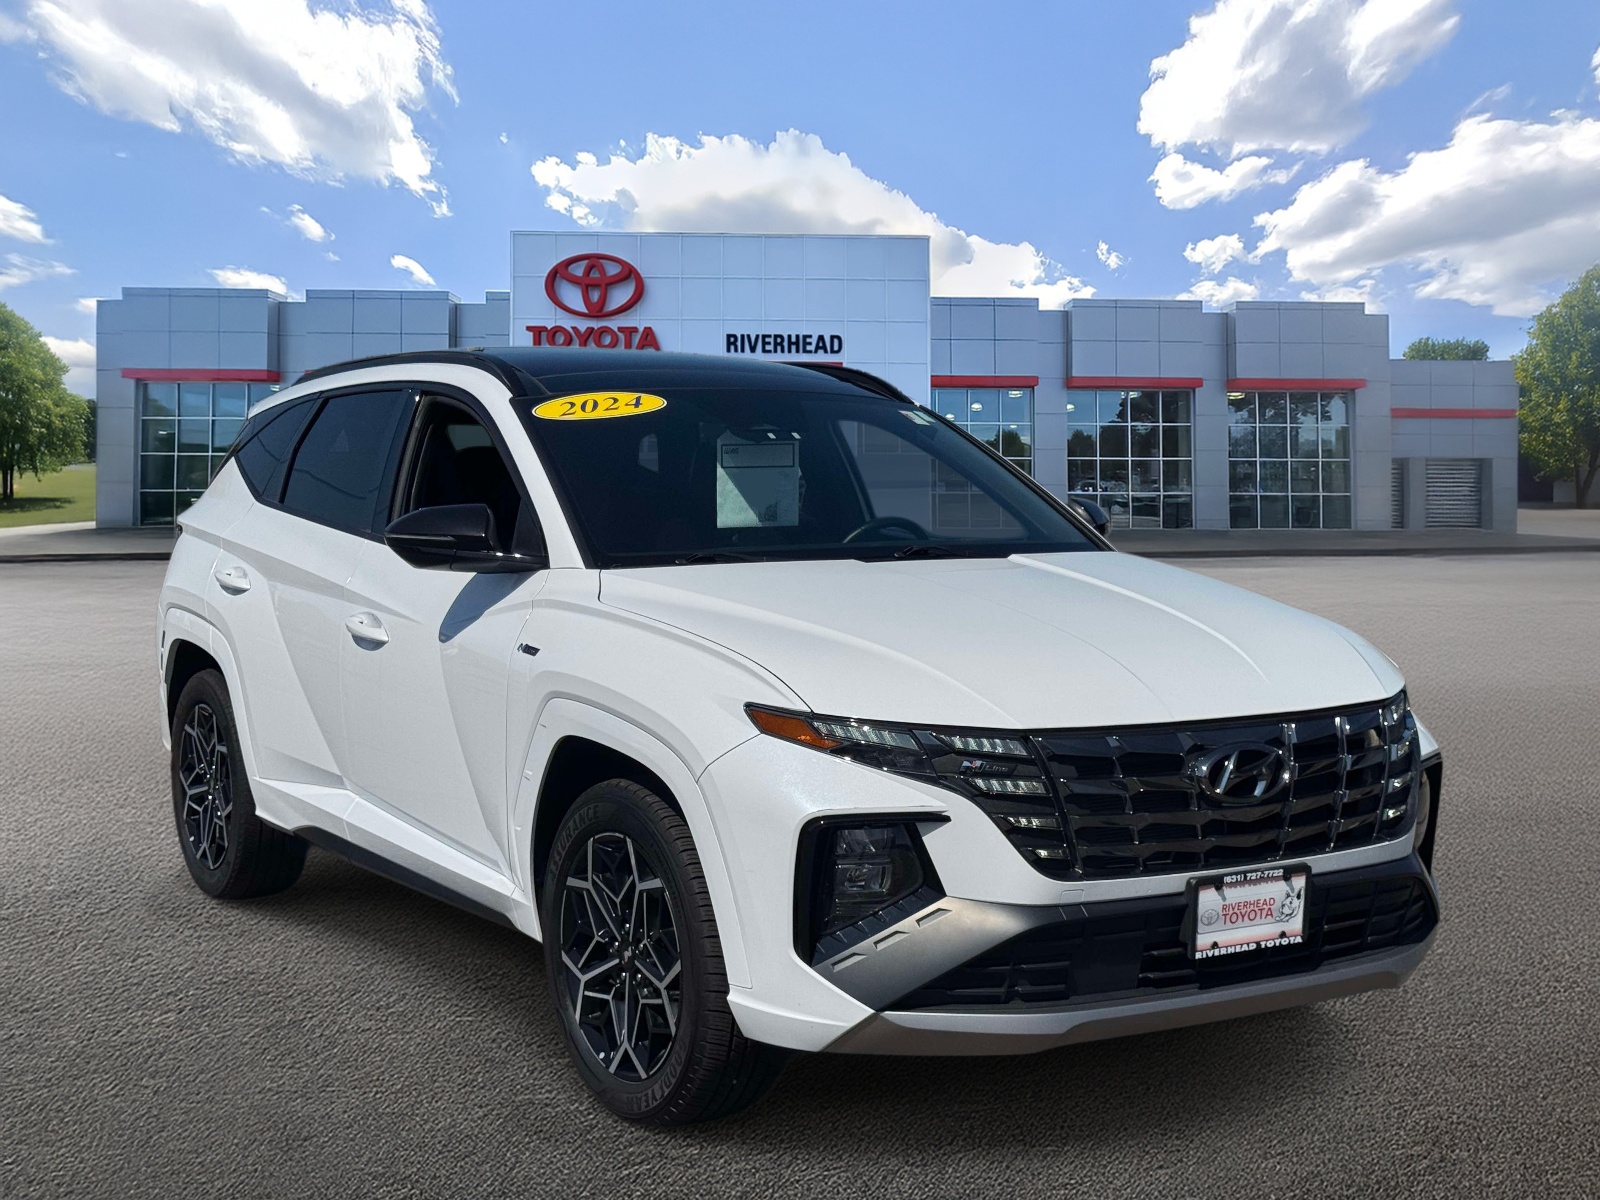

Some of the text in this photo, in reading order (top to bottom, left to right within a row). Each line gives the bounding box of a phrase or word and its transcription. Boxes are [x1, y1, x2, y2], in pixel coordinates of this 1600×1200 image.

[526, 325, 661, 351] TOYOTA
[725, 333, 843, 355] RIVERHEAD
[559, 395, 643, 417] 2024
[1223, 874, 1244, 884] (631)
[1222, 897, 1275, 913] RIVERHEAD
[1222, 908, 1274, 925] TOYOTA
[1195, 936, 1302, 959] RIVERHEAD TOYOTA
